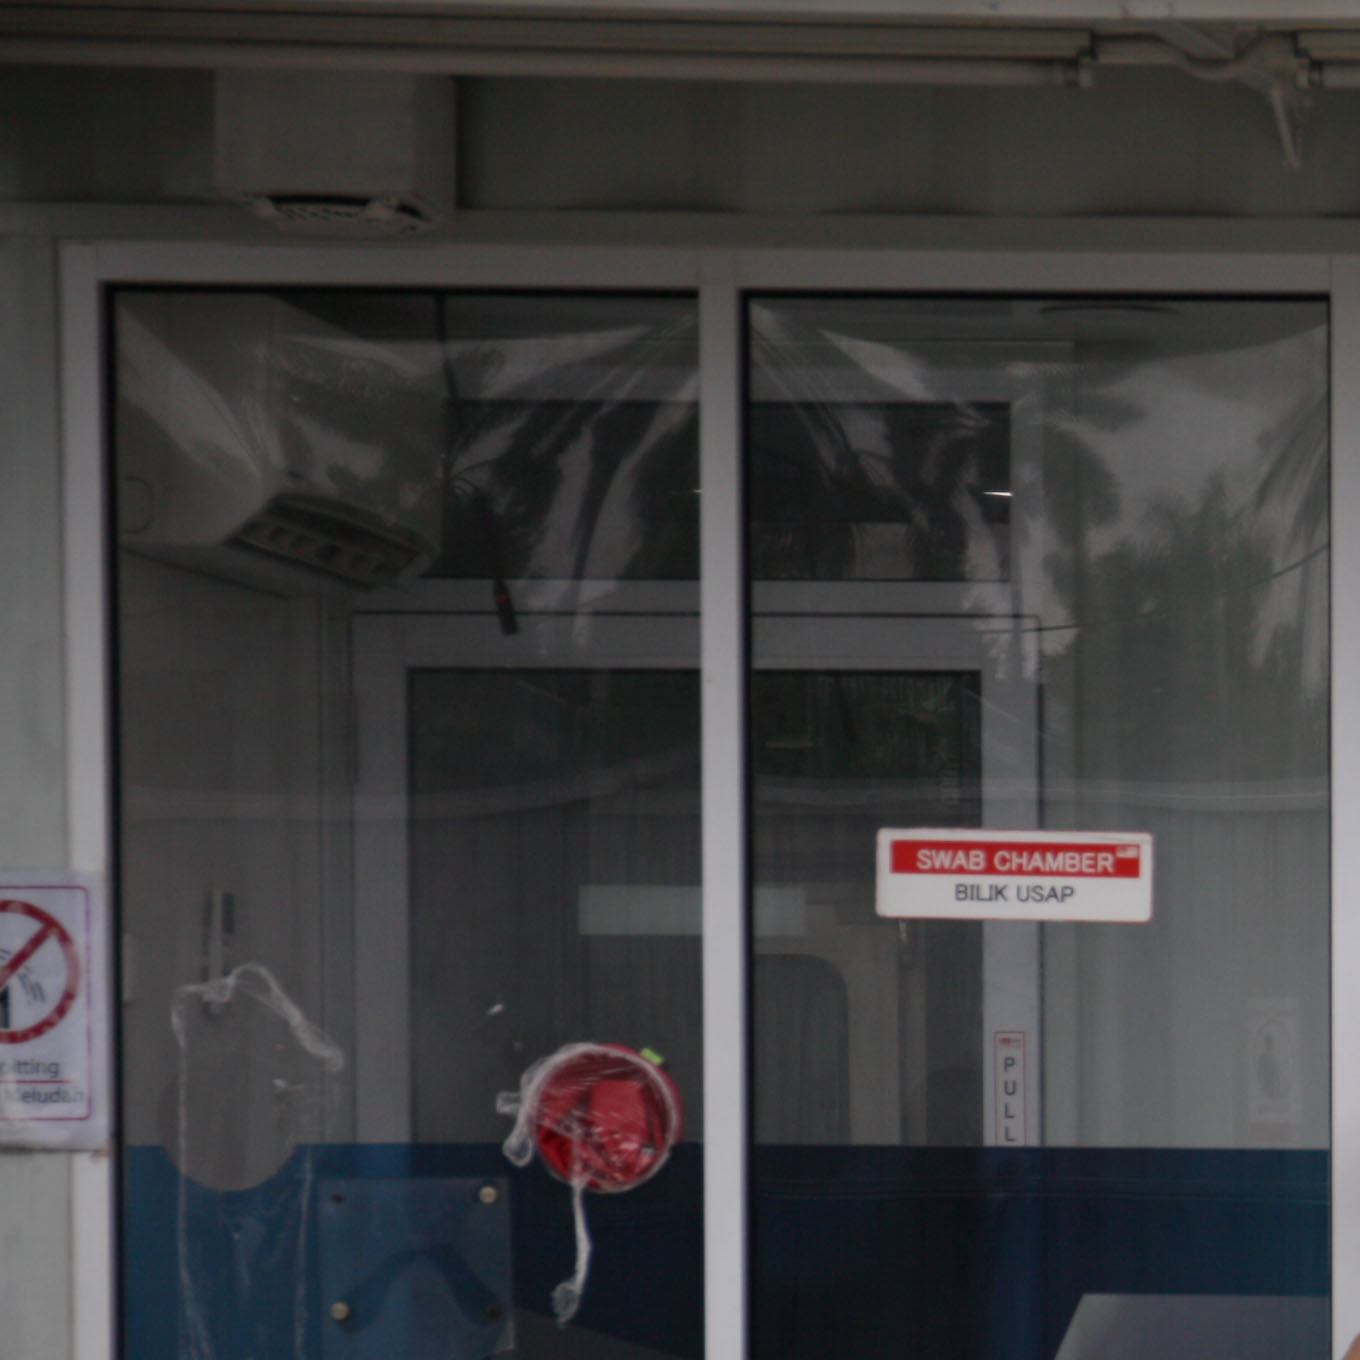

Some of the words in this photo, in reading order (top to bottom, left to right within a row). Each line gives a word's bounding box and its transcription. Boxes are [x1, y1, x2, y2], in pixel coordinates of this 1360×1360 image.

[916, 848, 986, 871] SWAB
[994, 850, 1115, 873] CHAMBER
[955, 883, 1008, 902] BILIK
[1017, 884, 1075, 903] USAP
[1003, 1057, 1016, 1142] PULL
